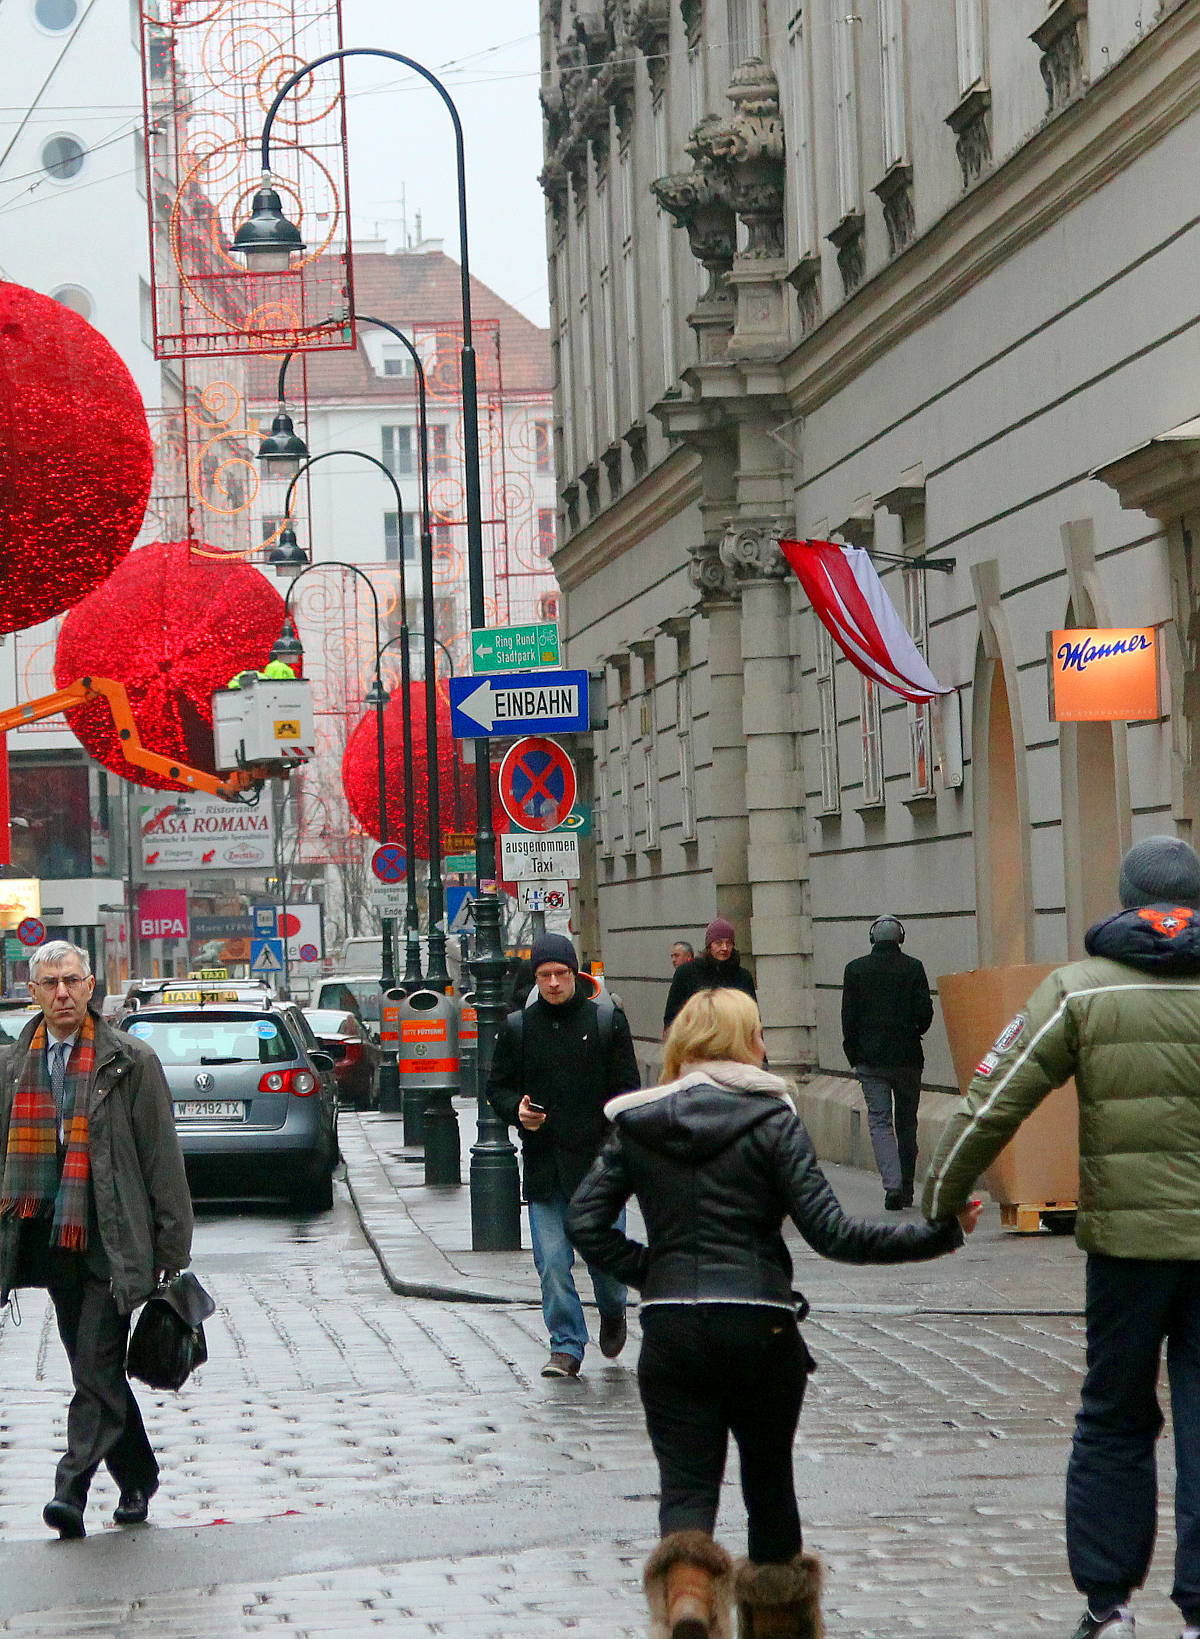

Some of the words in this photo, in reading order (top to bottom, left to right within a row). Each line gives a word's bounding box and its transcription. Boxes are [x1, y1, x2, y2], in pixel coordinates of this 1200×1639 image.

[495, 635, 513, 649] Ring
[516, 632, 536, 645] Rund
[496, 649, 536, 665] Stadtpark
[1056, 634, 1153, 671] Manner
[495, 689, 572, 718] EINBAHN
[206, 804, 260, 815] Ristorante
[193, 815, 269, 833] ROMANA
[506, 840, 575, 856] ausgenommen
[531, 857, 553, 873] Taxi
[385, 907, 403, 916] Ende
[141, 919, 185, 937] BIPA
[170, 992, 198, 1001] TAXI
[178, 1103, 187, 1115] W
[195, 1103, 222, 1115] 2192
[225, 1102, 239, 1114] TX
